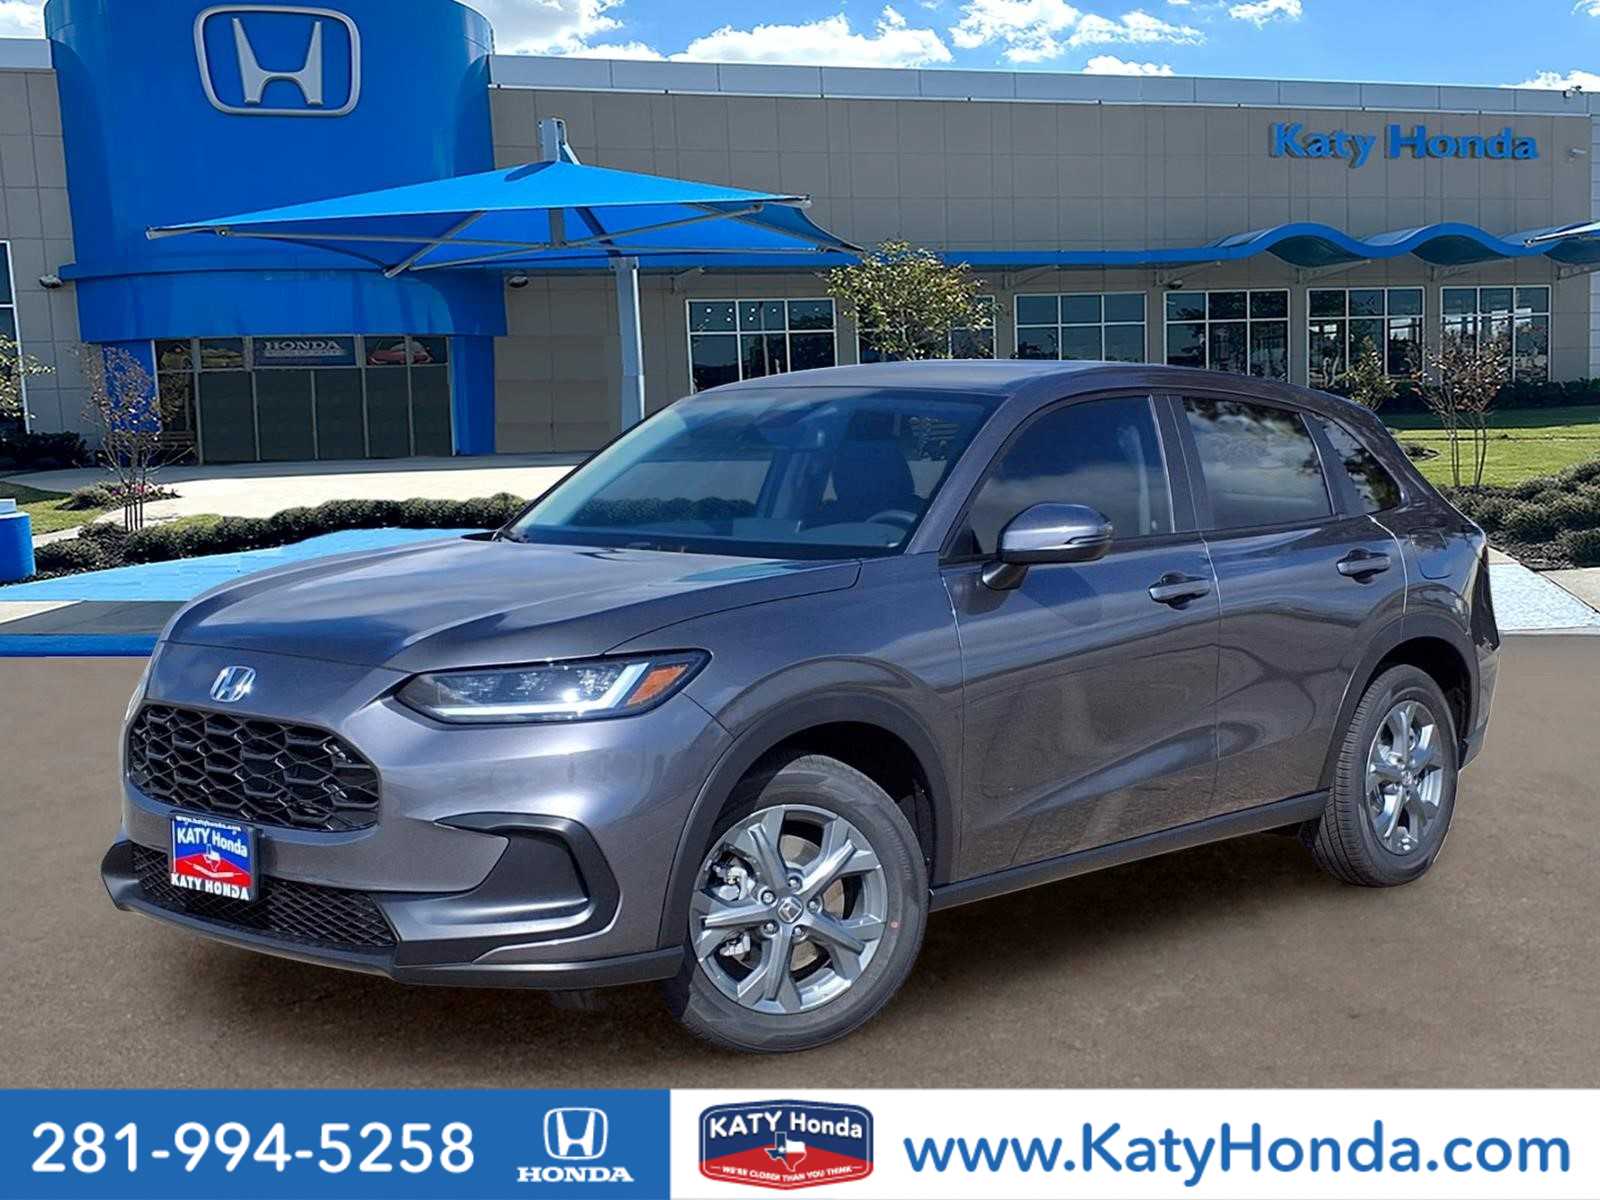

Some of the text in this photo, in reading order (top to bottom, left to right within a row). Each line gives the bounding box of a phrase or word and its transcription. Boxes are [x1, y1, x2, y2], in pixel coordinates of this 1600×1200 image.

[1270, 121, 1540, 169] Katy Honda
[264, 341, 342, 351] HONDA
[177, 827, 248, 858] KATY Honda
[171, 872, 249, 901] KATY HONDA
